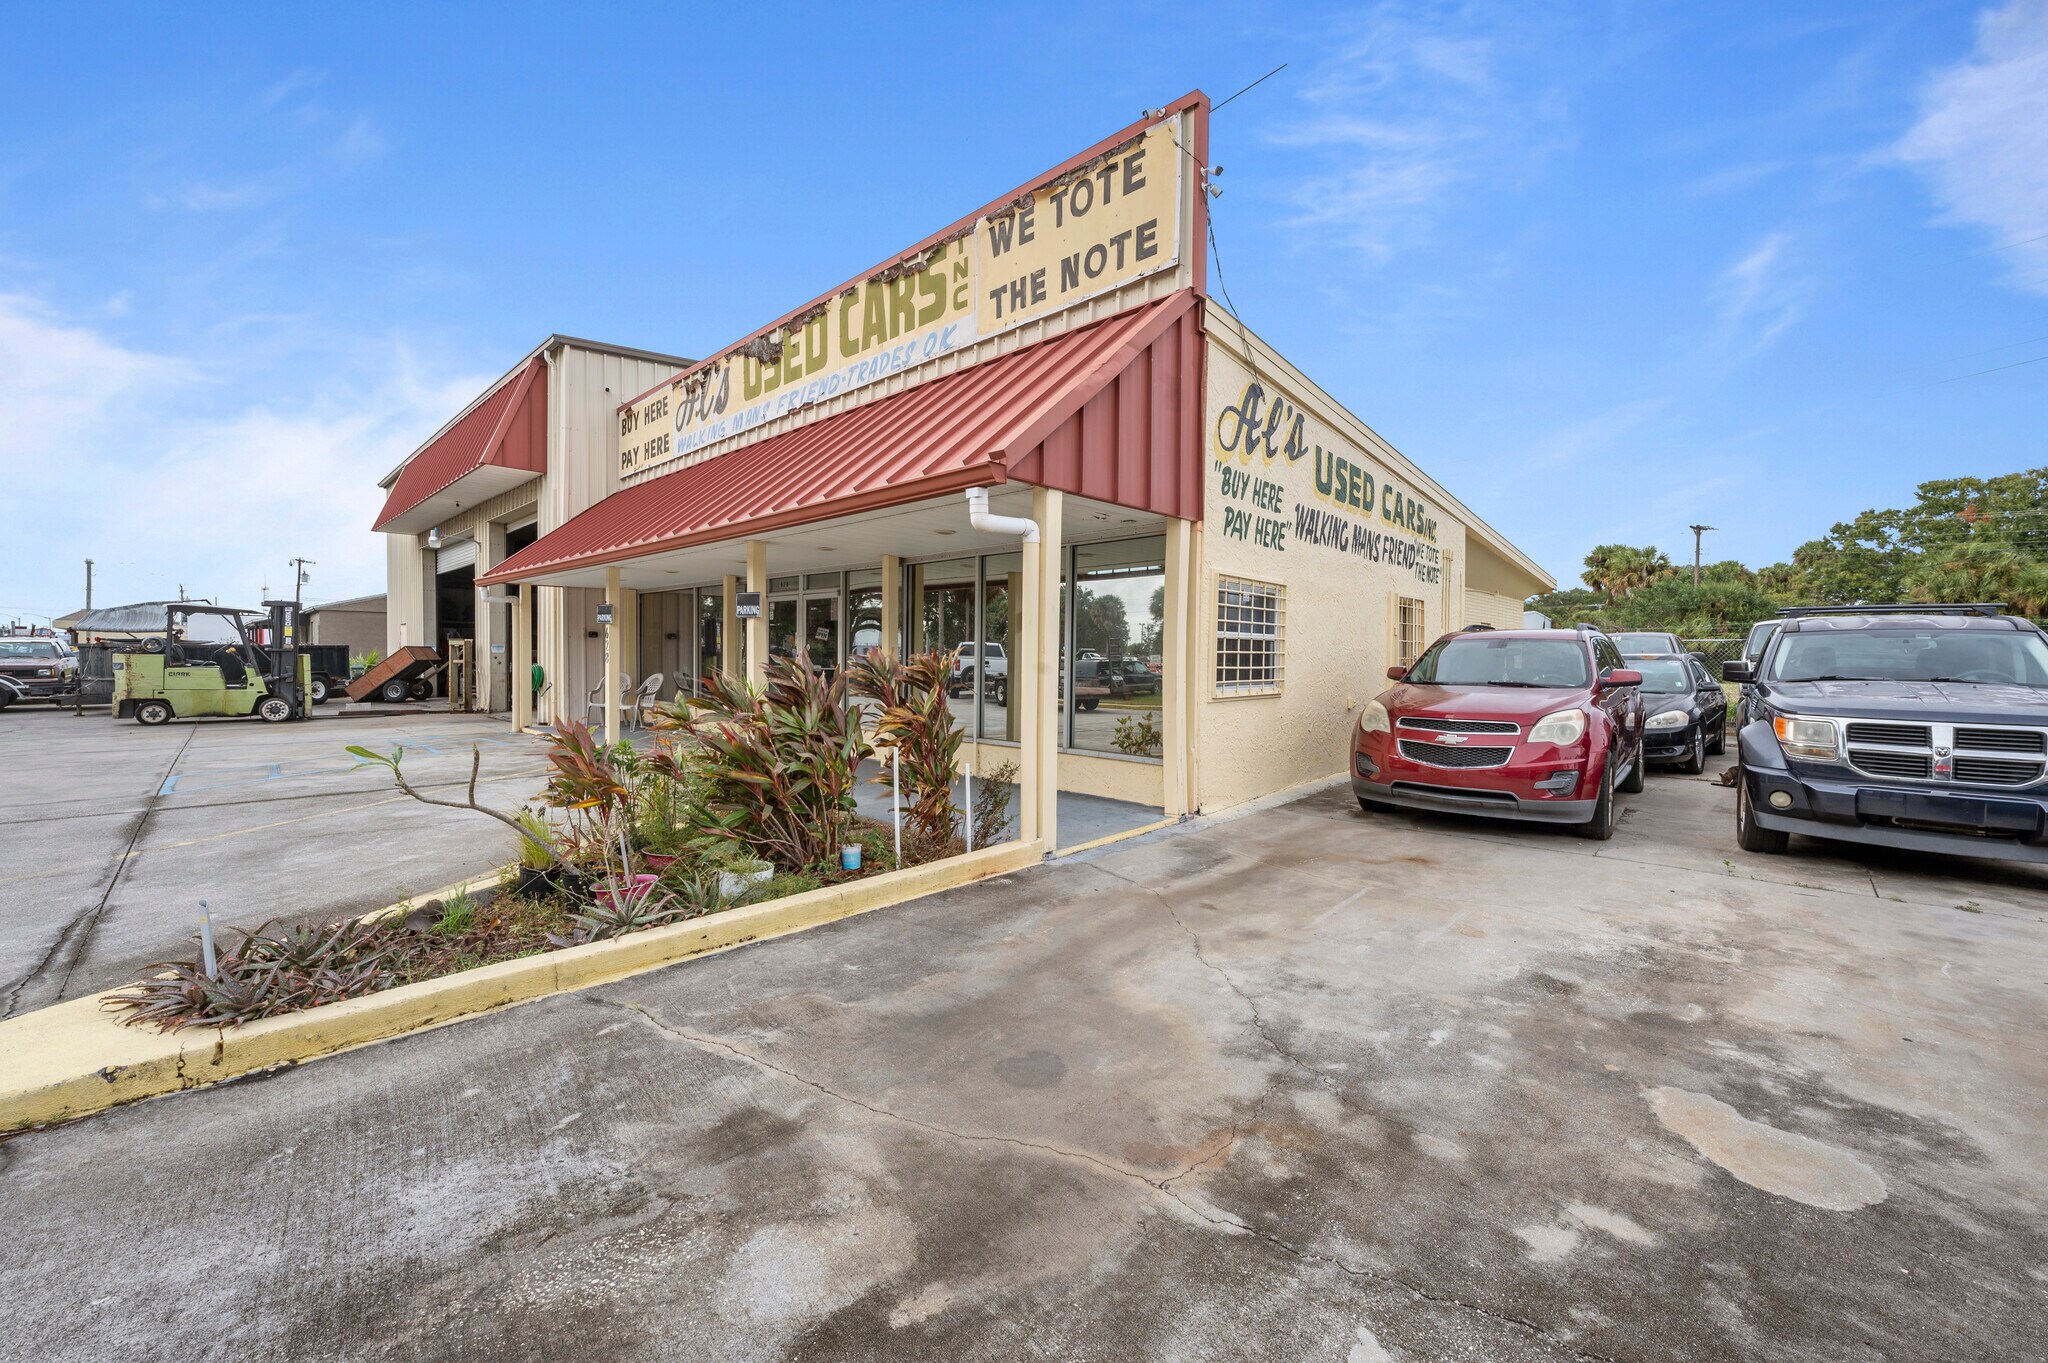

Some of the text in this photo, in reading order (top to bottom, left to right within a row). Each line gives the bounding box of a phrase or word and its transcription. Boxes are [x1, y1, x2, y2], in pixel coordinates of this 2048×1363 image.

[988, 149, 1146, 258] WE TOTE
[989, 218, 1158, 319] THE NOTE
[743, 312, 828, 401] USED
[839, 243, 947, 358] CARS
[677, 421, 726, 454] WALKING
[732, 402, 770, 430] MANS
[923, 324, 958, 358] OK
[621, 395, 669, 437] BUY HERE
[621, 433, 670, 470] PAY HERE
[1216, 383, 1308, 463] Al's
[1314, 445, 1375, 515] USED
[1382, 484, 1425, 535] CARS
[1252, 477, 1284, 514] HERE
[1223, 506, 1252, 541] PAY
[1295, 503, 1416, 570] WALKING MANS FRIEND
[1414, 562, 1426, 582] THE
[1426, 544, 1440, 564] TOTE
[736, 604, 760, 615] PARKING
